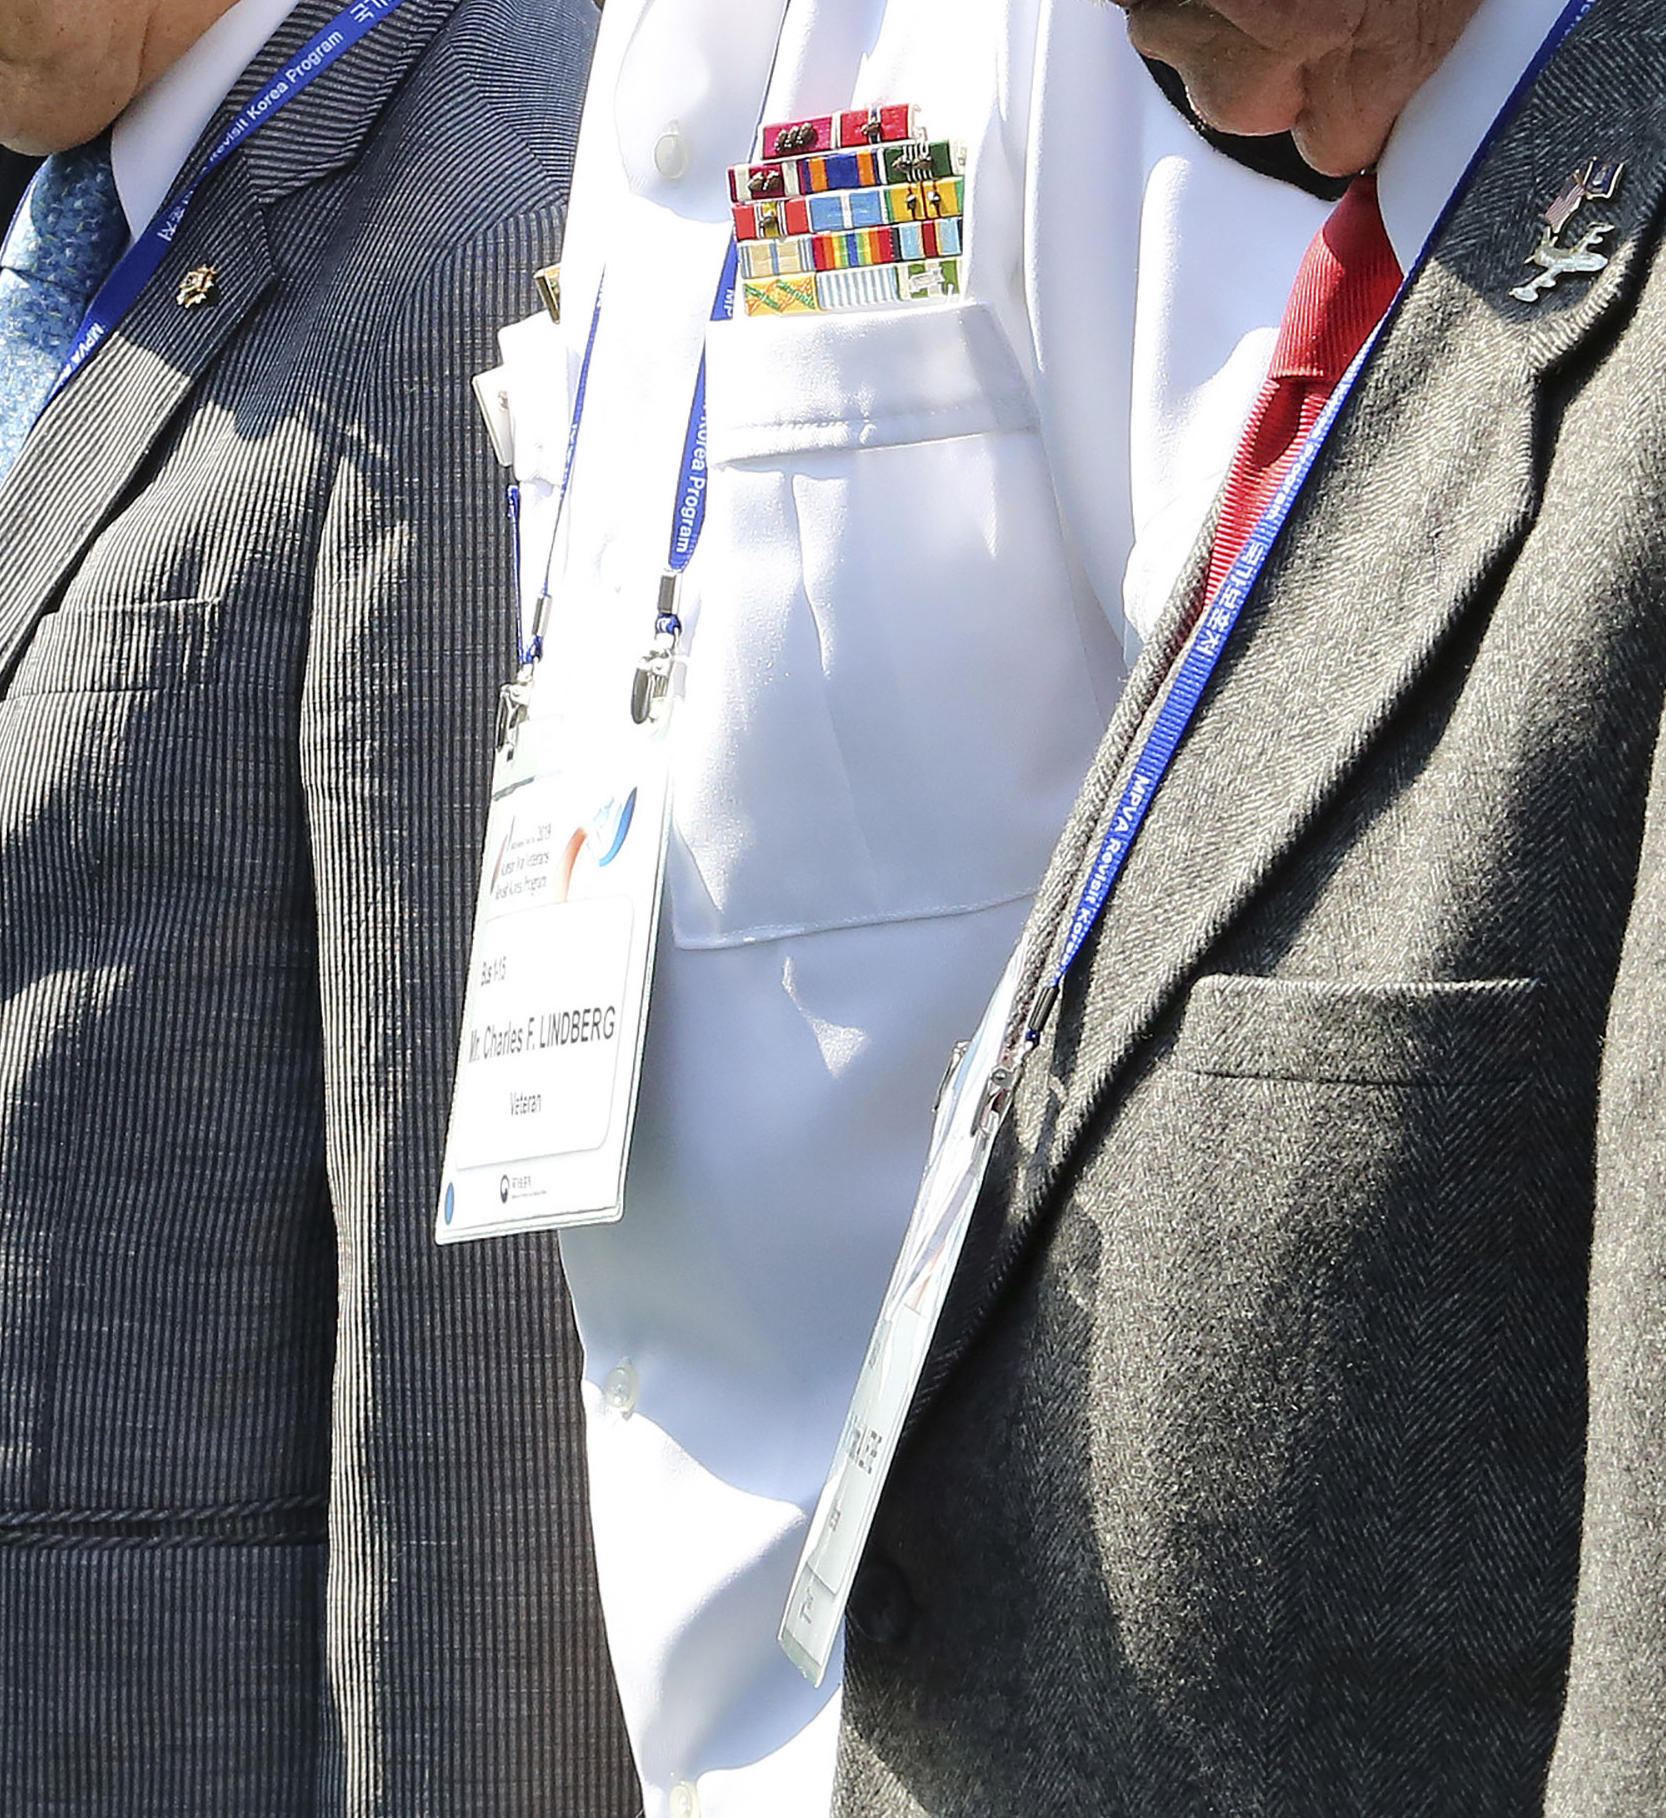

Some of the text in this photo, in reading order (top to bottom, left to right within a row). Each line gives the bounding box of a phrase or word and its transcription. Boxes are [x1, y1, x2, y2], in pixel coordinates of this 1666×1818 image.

[246, 79, 289, 120] Korea
[286, 30, 344, 83] Program
[676, 475, 705, 554] Program
[1197, 542, 1266, 657] 국가보훈처
[1113, 773, 1150, 832] MPVA
[1085, 837, 1121, 903] Revisit
[483, 1021, 523, 1059] Charles
[526, 1017, 536, 1051] F.
[539, 1006, 616, 1049] LINDBERG
[510, 1092, 542, 1116] Veteran
